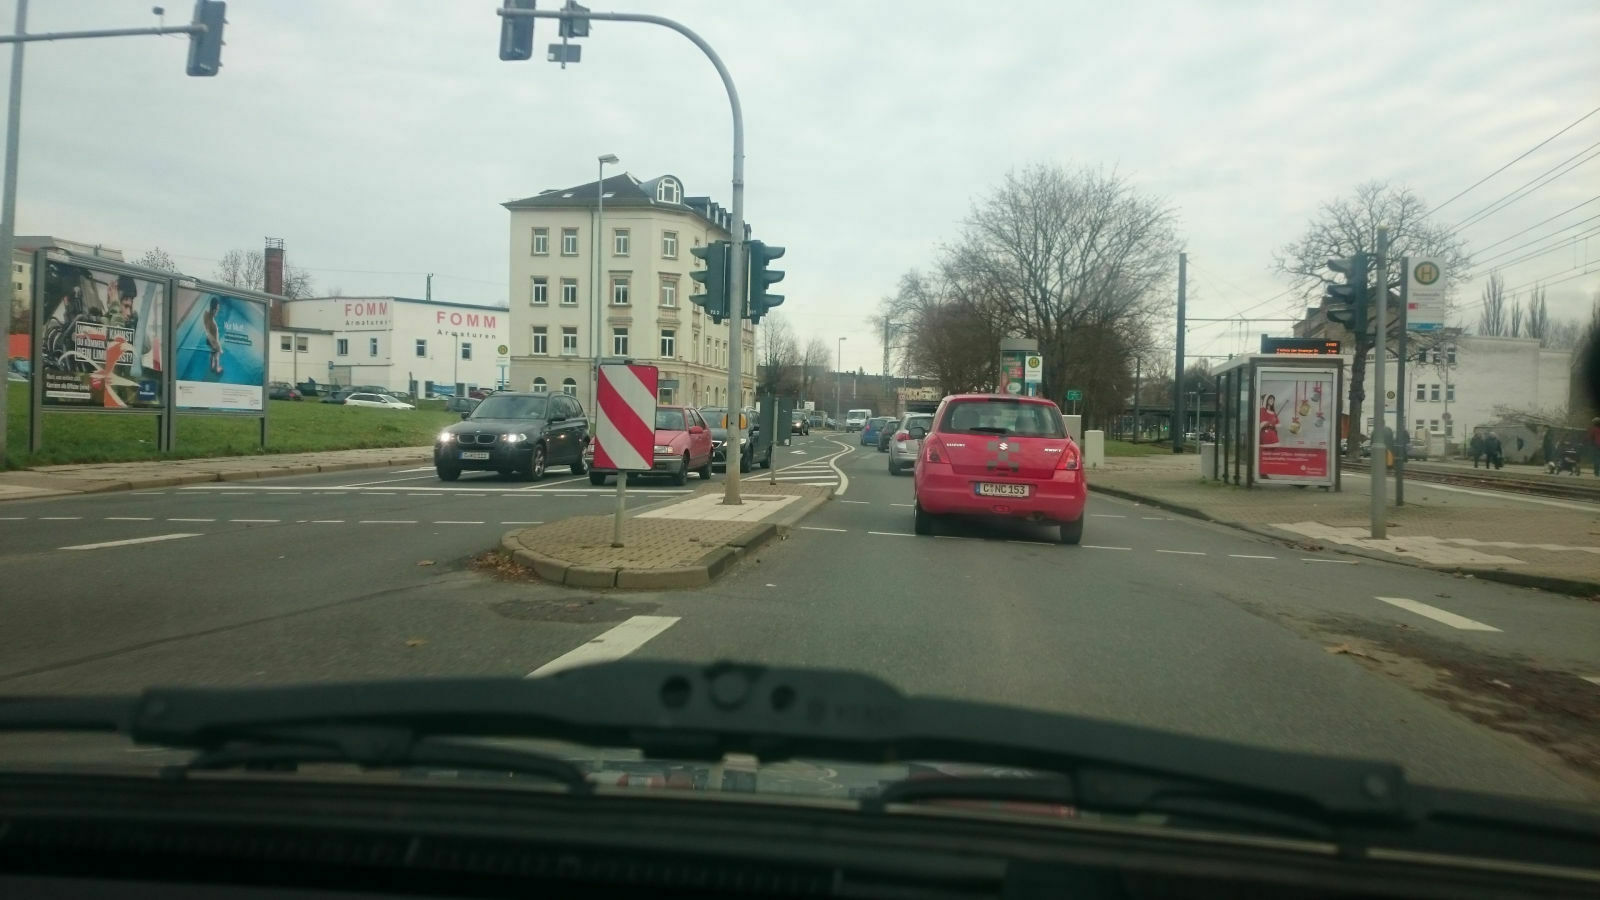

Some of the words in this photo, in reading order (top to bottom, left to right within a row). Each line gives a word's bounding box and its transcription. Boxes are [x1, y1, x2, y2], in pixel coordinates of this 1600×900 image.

[345, 302, 388, 317] FOMM
[437, 311, 496, 329] FOMM
[437, 329, 496, 340] Armaturen
[1008, 485, 1025, 495] 153
